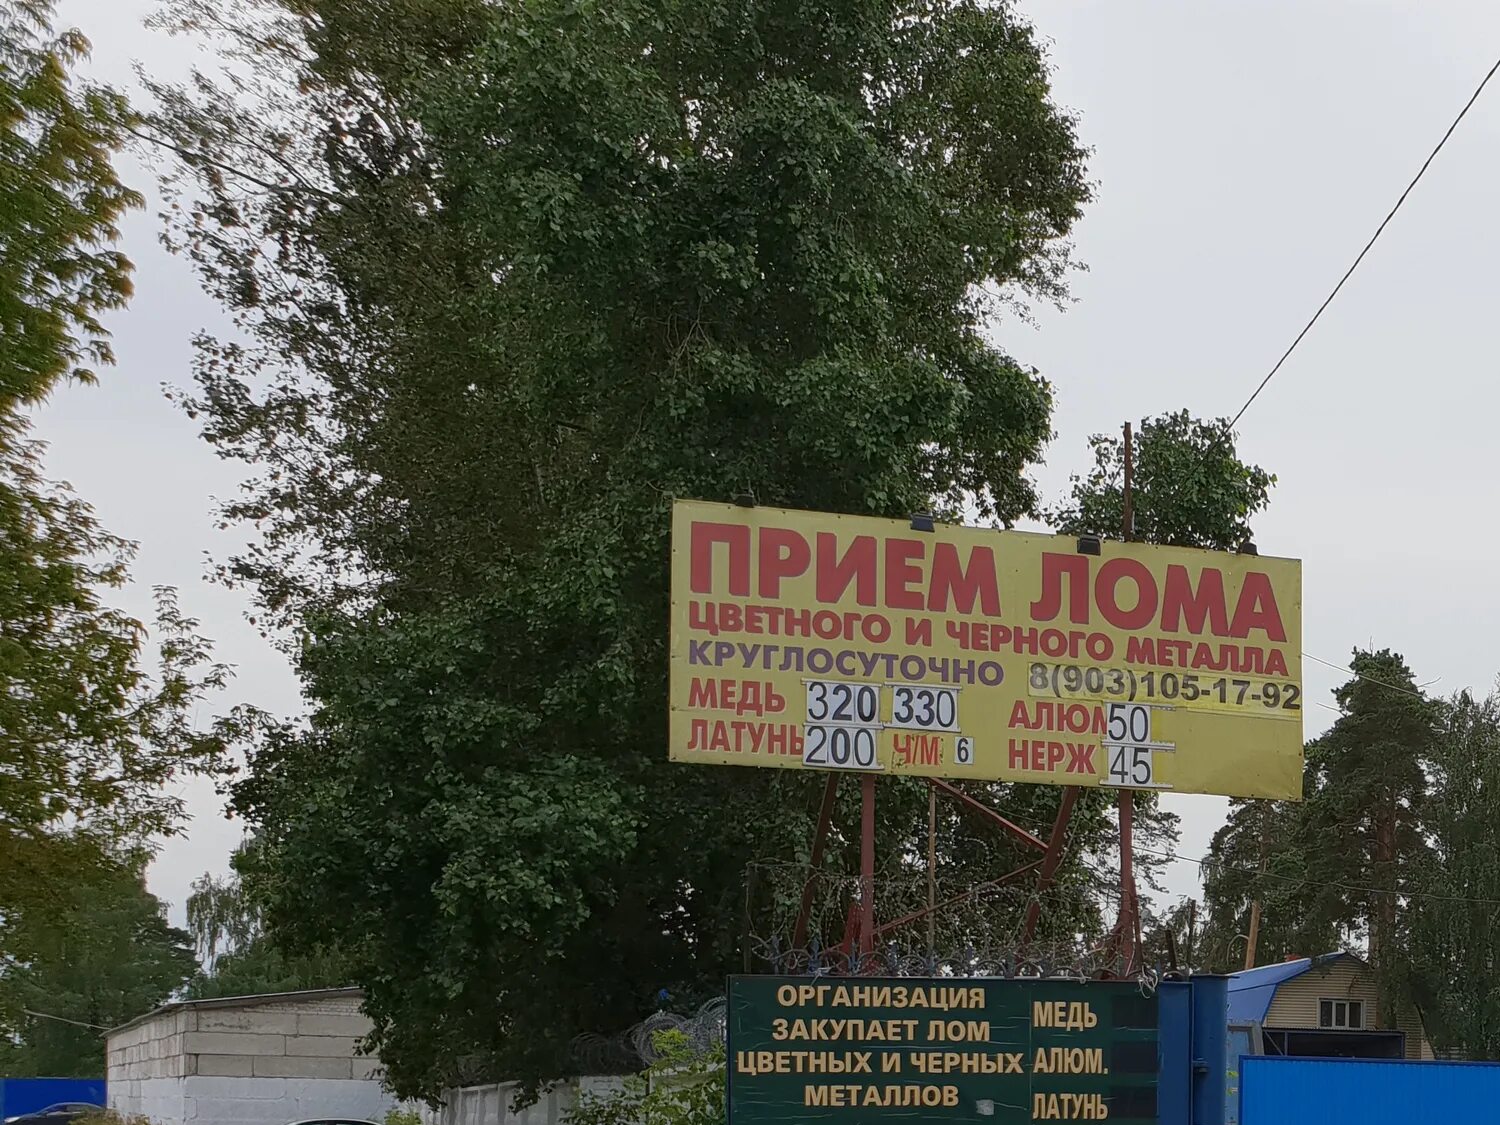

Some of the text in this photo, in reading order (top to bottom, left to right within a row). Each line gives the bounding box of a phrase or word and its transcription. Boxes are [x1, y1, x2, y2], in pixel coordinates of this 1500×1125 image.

[689, 520, 1288, 642] ПРИЕМ ЛОМА
[689, 601, 1289, 676] ЦВЕТНОГО И ЧЕРНОГО МЕТАЛЛА
[688, 640, 1005, 687] КРУГЛОСУТОЧНО
[687, 678, 957, 728] МЕДЬ 320 330
[1029, 661, 1301, 711] 8(903)105-17-92
[1108, 703, 1149, 743] 50
[687, 718, 876, 767] ЛАТУНЬ 200
[893, 733, 970, 767] Ч/М 6
[1008, 737, 1151, 785] НЕРЖ 45
[776, 984, 987, 1011] ОРГАНИЗАЦИЯ
[1033, 1001, 1098, 1030] МЕДЬ
[772, 1018, 991, 1041] ЗАКУПАЕТ ЛОМ
[736, 1050, 1024, 1076] ЦВЕТНЫХ И ЧЕРНЫХ
[1033, 1047, 1108, 1075] АЛЮМ.
[803, 1085, 959, 1107] МЕТАЛЛОВ
[1032, 1092, 1108, 1121] ЛАТУНЬ
